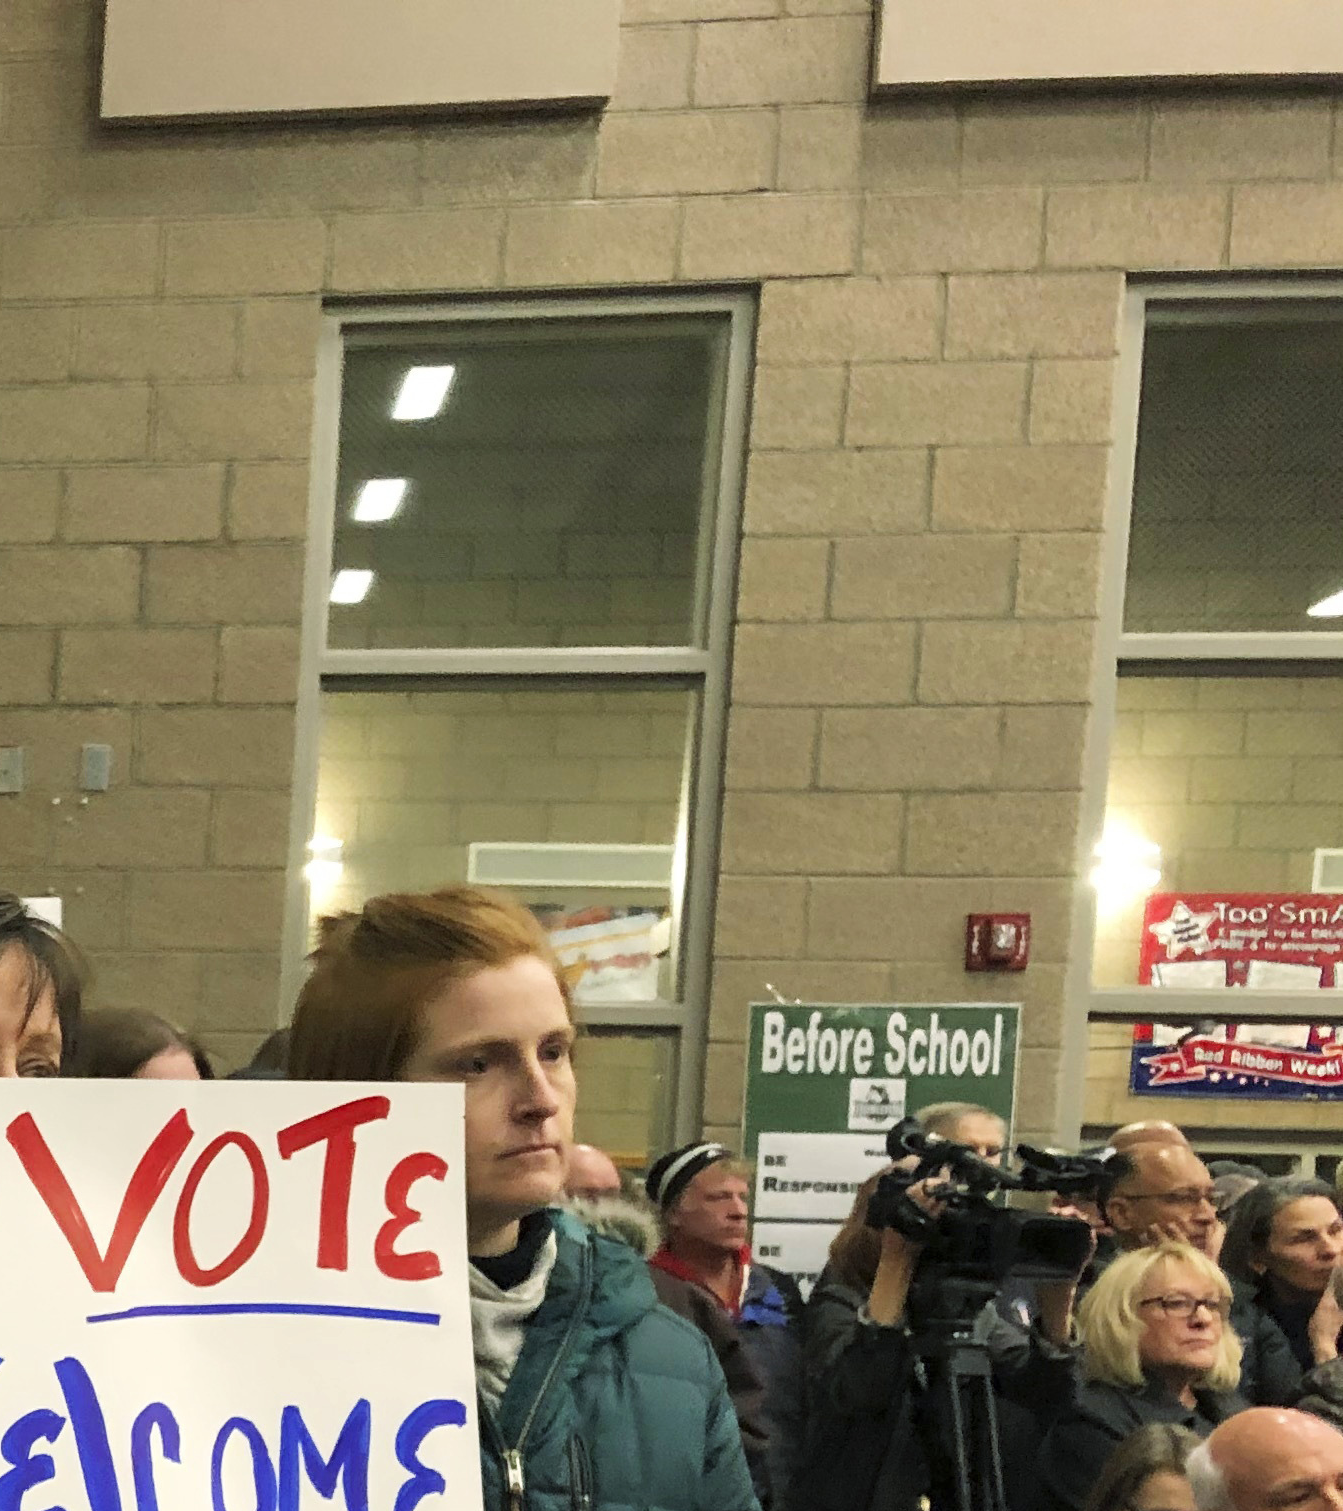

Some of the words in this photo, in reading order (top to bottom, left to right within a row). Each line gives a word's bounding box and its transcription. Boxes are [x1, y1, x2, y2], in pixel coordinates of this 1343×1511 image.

[762, 1011, 875, 1075] Before
[884, 1012, 1003, 1077] School
[7, 1096, 448, 1292] VOTE
